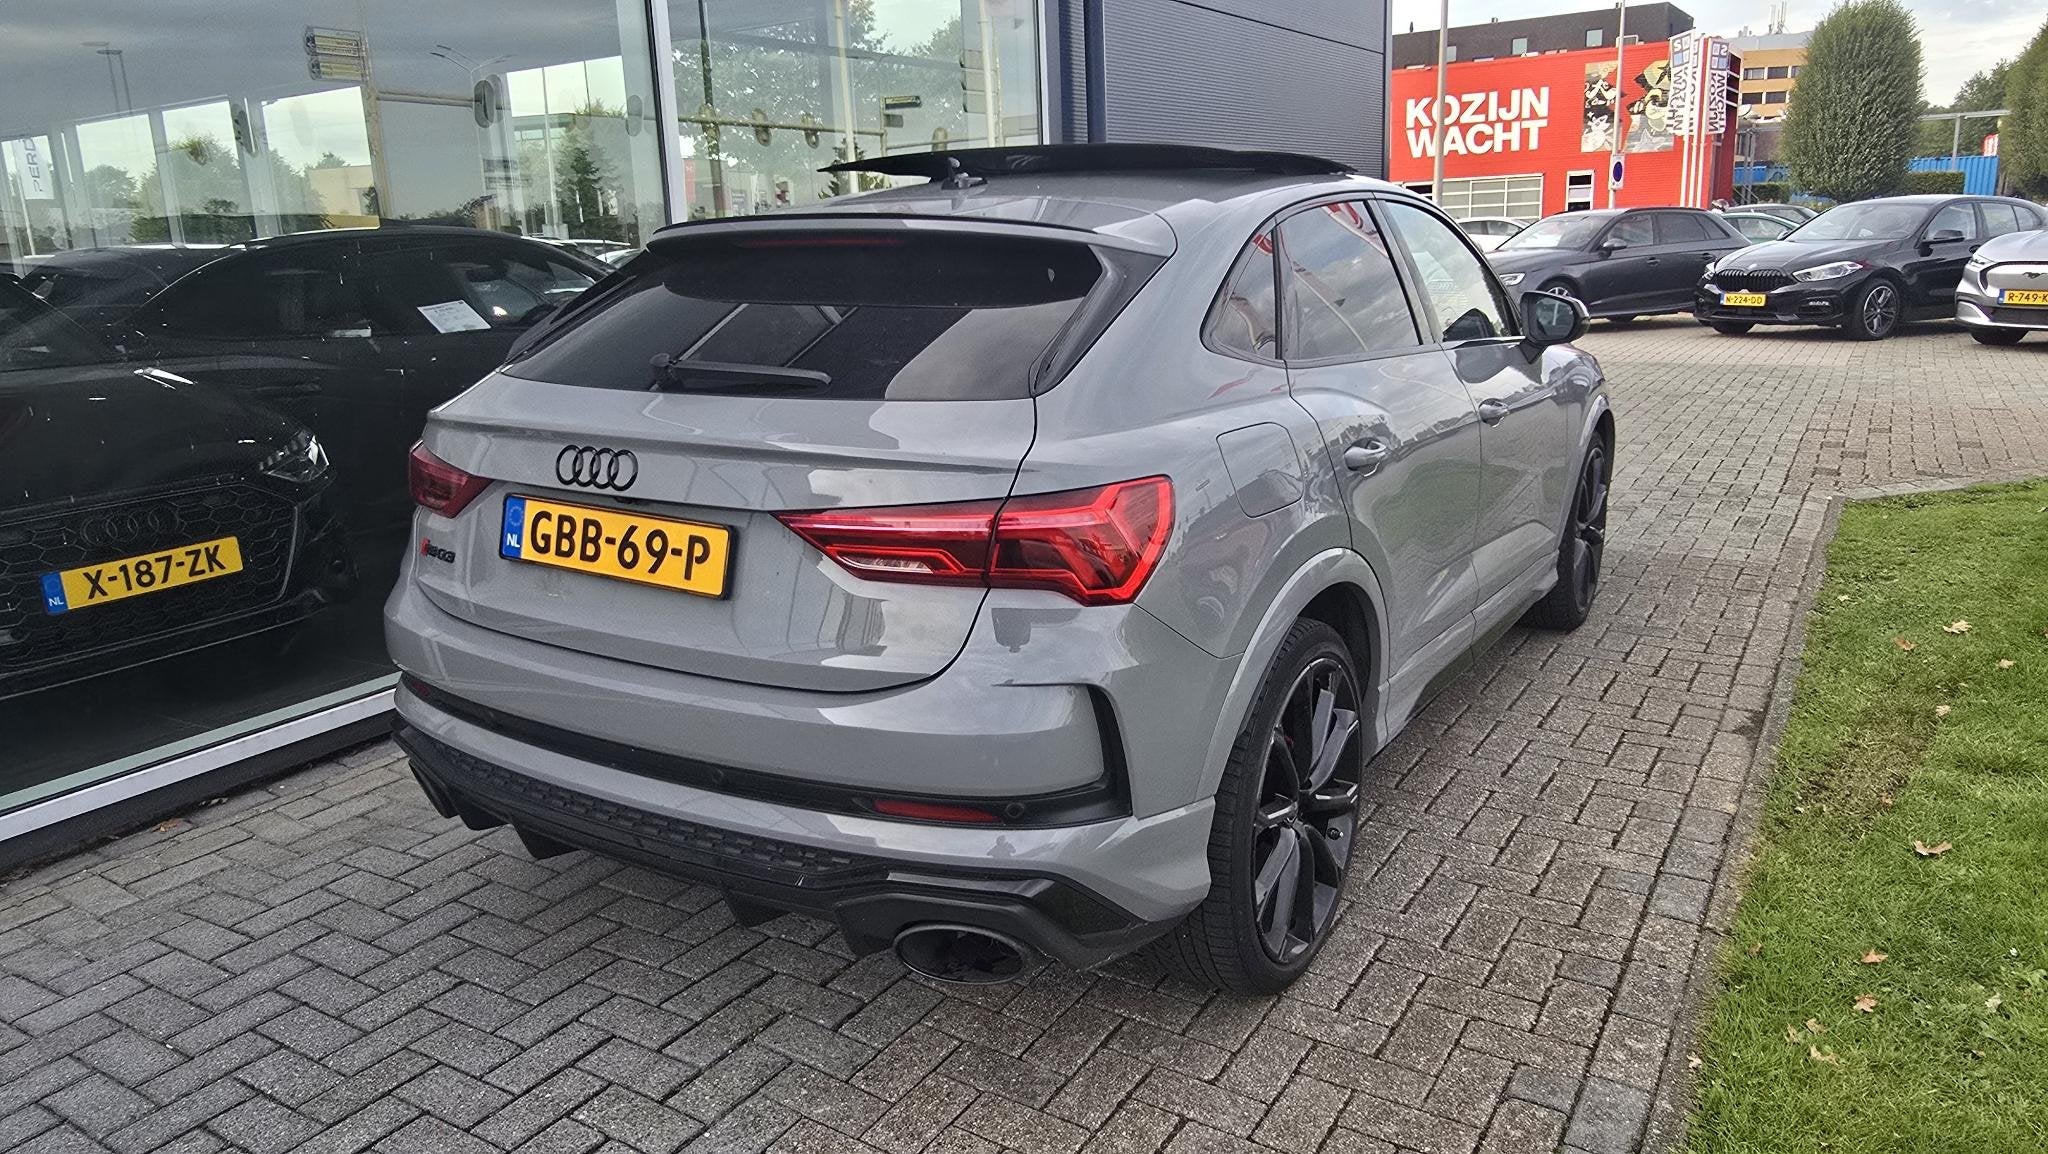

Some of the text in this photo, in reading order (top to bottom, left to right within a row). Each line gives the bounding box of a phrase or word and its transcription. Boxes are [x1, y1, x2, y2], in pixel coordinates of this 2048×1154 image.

[1405, 86, 1549, 129] KOZIJN
[1406, 119, 1548, 158] WACHT
[1726, 295, 1763, 304] N-224-DD
[506, 510, 711, 581] NL GBB-69-P
[48, 544, 226, 607] NL X-187-ZK
